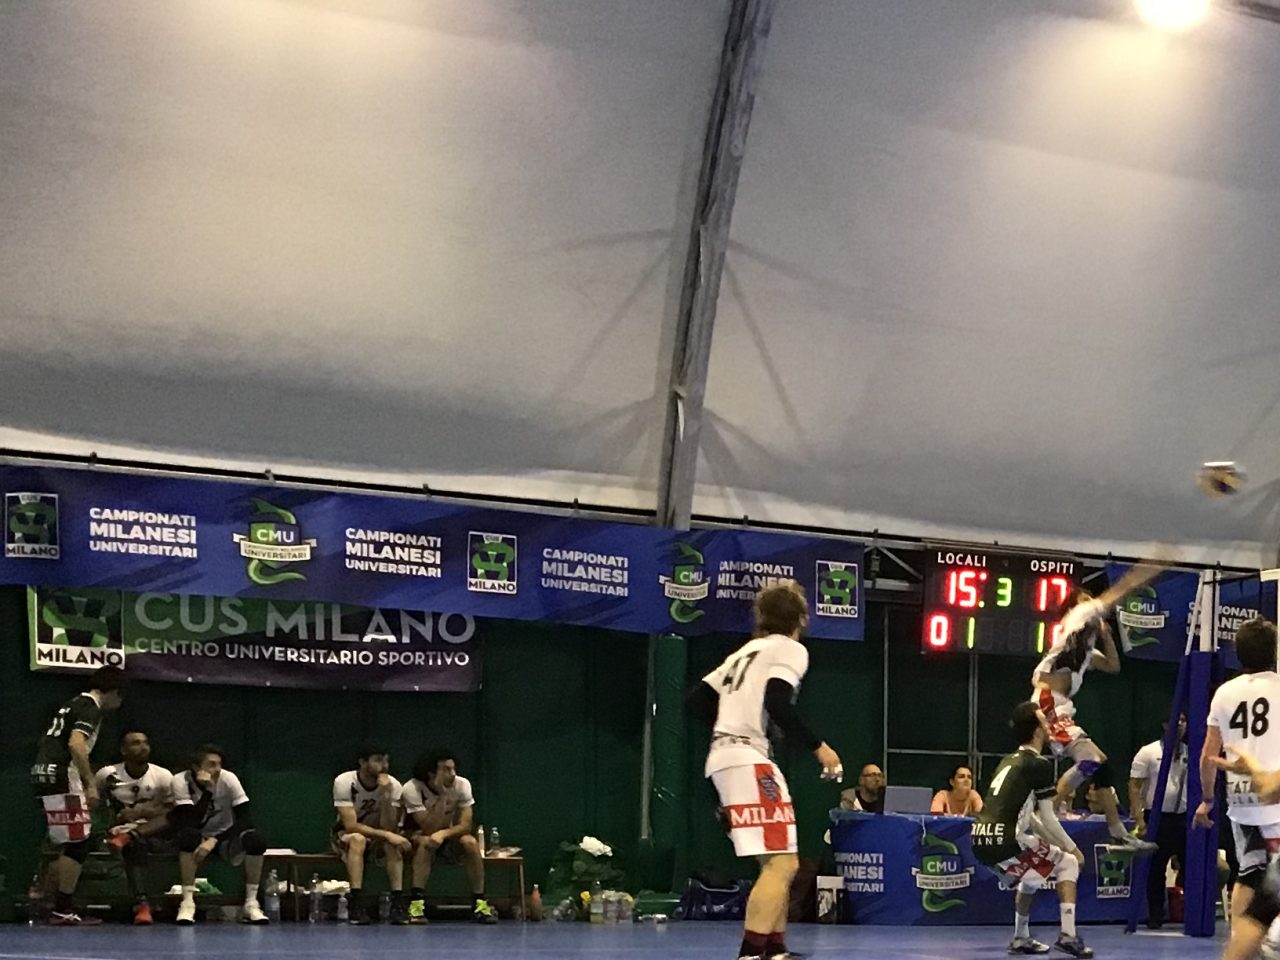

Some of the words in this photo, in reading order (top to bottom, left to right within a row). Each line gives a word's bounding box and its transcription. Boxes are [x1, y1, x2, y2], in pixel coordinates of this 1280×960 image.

[89, 507, 196, 527] CAMPIONATI
[89, 521, 197, 544] MILANESI
[256, 528, 294, 543] CMU
[345, 527, 441, 548] CAMPIONATI
[6, 545, 57, 558] MILANO
[89, 540, 198, 558] UNIVERSITARI
[243, 549, 307, 560] UNIVERSITARI
[345, 541, 441, 565] MILANESI
[542, 548, 629, 568] CAMPIONATI
[345, 558, 442, 578] UNIVERSITARI
[937, 552, 987, 567] LOCALI
[1030, 559, 1074, 575] OSPITI
[542, 561, 629, 584] MILANESI
[468, 581, 516, 592] MILANO
[541, 577, 629, 597] UNIVERSITARI
[996, 577, 1012, 607] 3
[817, 605, 857, 617] MILANO
[1129, 601, 1156, 613] CMU
[134, 592, 249, 636] CUS
[265, 600, 477, 644] MILANO
[930, 615, 949, 646] 0
[967, 616, 976, 649] 1
[37, 648, 123, 667] MILANO
[135, 638, 220, 657] CENTRO
[225, 643, 374, 666] UNIVERSITARIO
[377, 650, 470, 666] SPORTIVO
[1228, 697, 1270, 740] 48
[990, 765, 1012, 797] 4
[926, 860, 957, 873] CMU
[1097, 888, 1130, 897] MILANO
